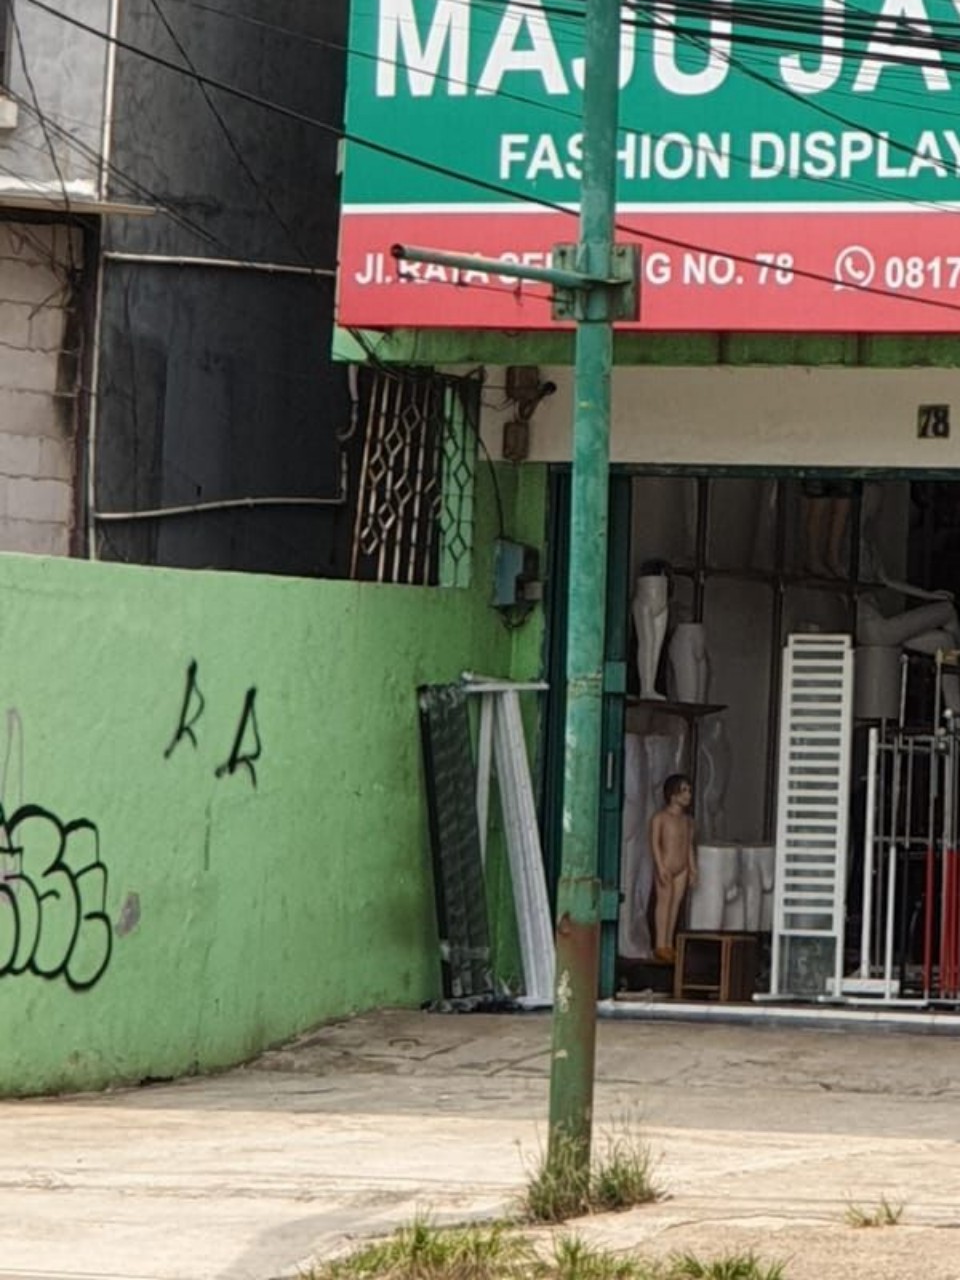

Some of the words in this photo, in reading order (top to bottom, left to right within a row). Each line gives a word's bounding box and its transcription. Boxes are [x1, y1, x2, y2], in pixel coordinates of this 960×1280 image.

[499, 131, 730, 180] FASHION
[683, 252, 744, 284] NO.
[756, 253, 795, 286] 78
[918, 404, 950, 439] 78
